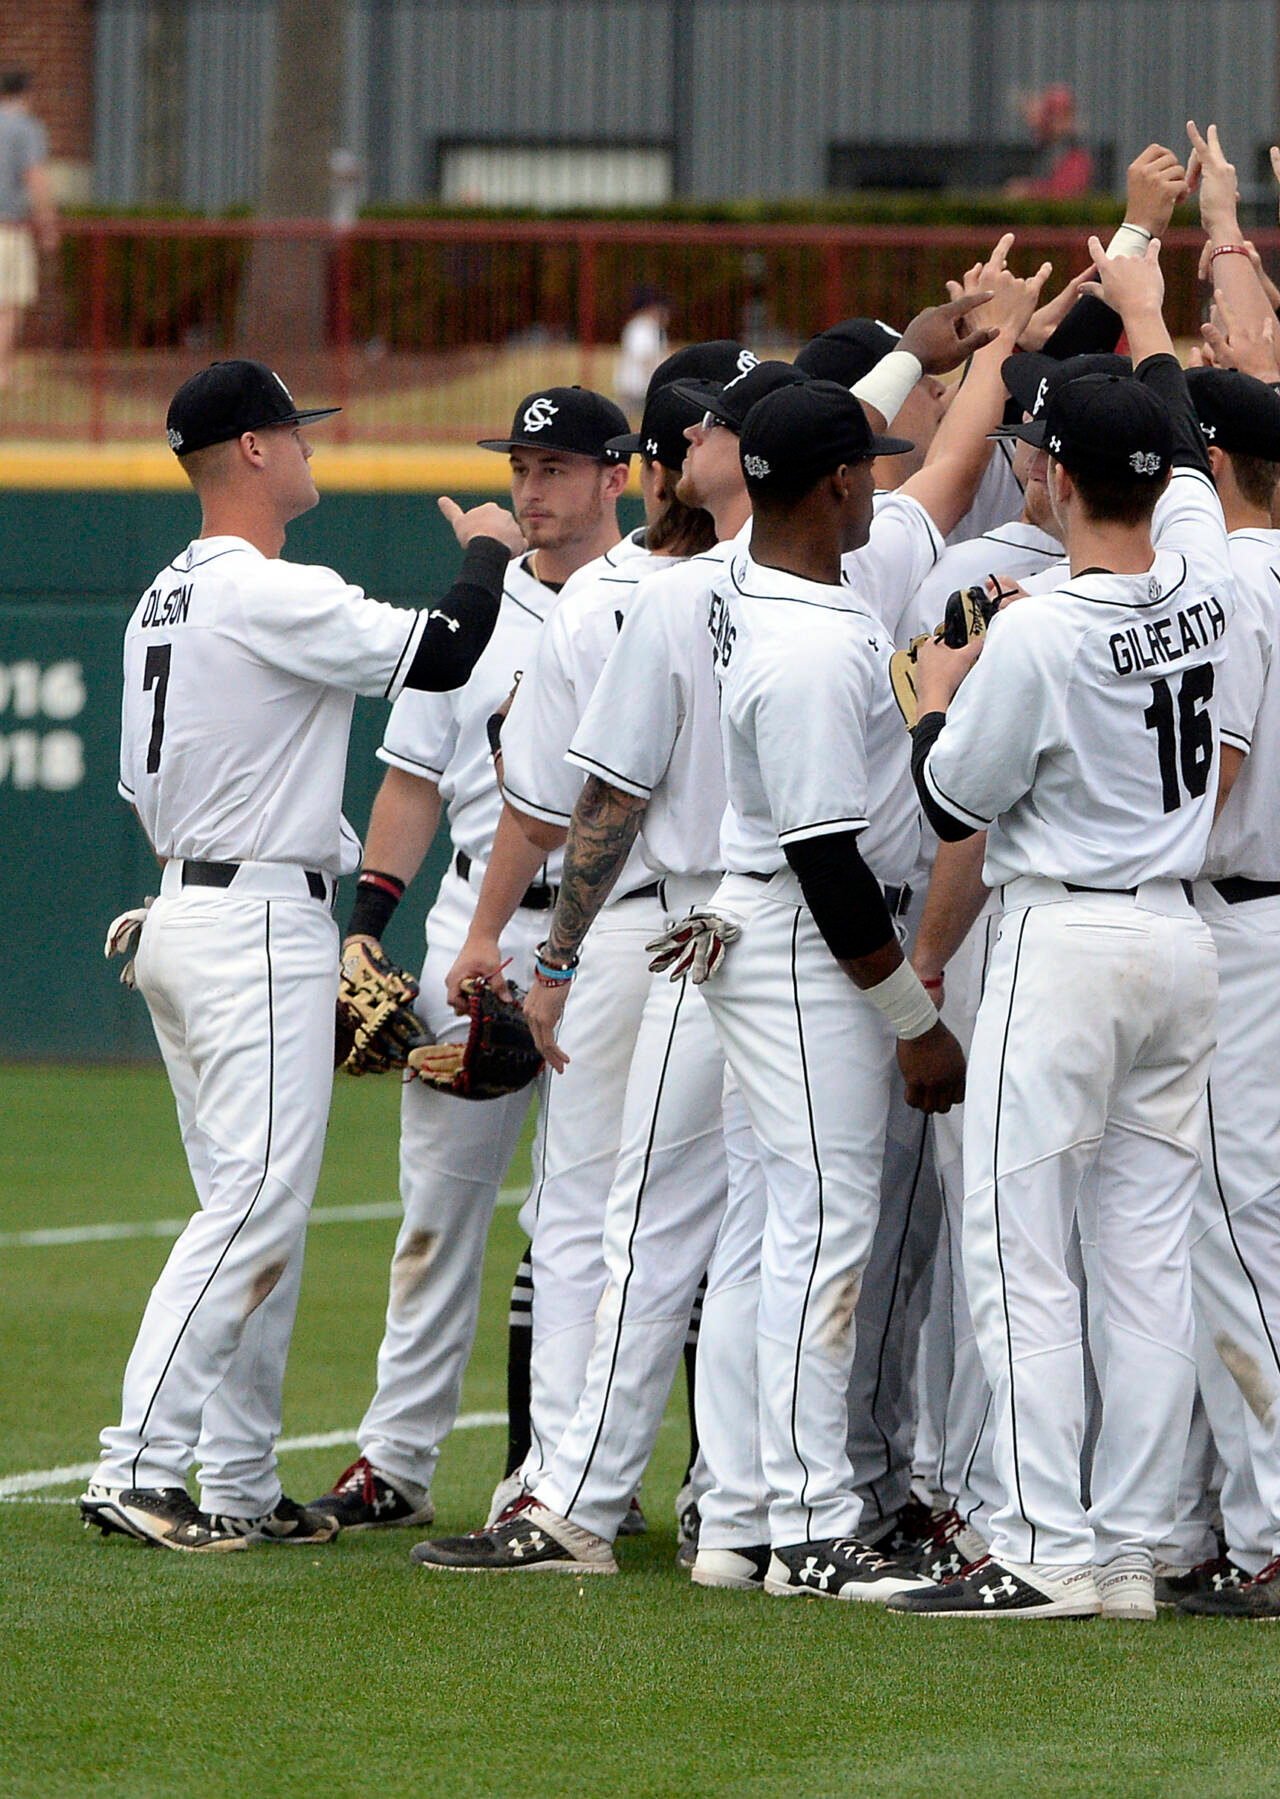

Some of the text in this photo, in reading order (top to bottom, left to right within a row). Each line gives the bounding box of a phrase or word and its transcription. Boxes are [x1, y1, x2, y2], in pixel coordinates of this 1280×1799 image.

[523, 398, 560, 432] SC
[141, 583, 194, 628] OLSON
[1109, 597, 1226, 676] GILREATH
[0, 660, 87, 720] 16
[142, 643, 173, 774] 7
[0, 730, 86, 792] 18
[1144, 661, 1215, 815] 16
